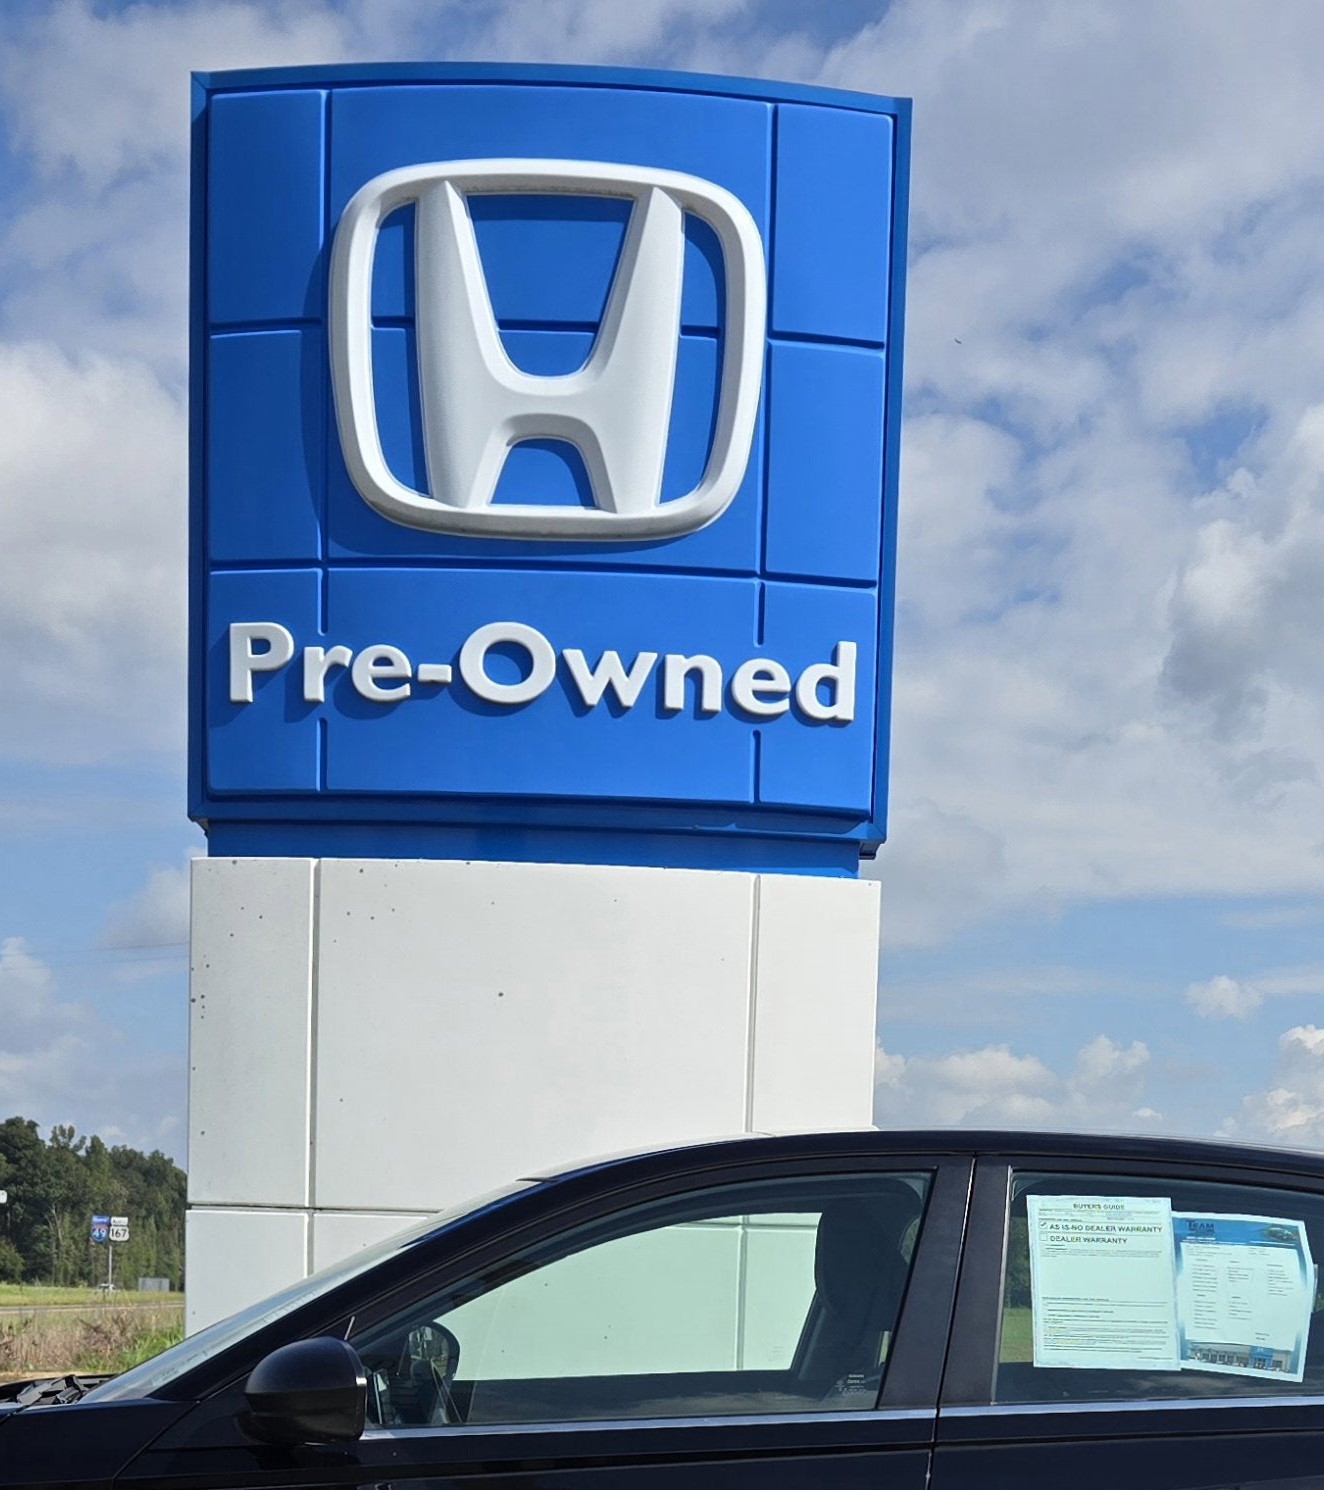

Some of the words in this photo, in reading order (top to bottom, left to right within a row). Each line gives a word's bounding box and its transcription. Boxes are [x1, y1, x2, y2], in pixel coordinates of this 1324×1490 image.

[229, 621, 857, 721] Pre-Owned
[111, 1228, 127, 1237] 167
[1085, 1224, 1116, 1232] DEALER
[1118, 1225, 1163, 1233] WARRANTY
[1049, 1235, 1081, 1243] DEALER
